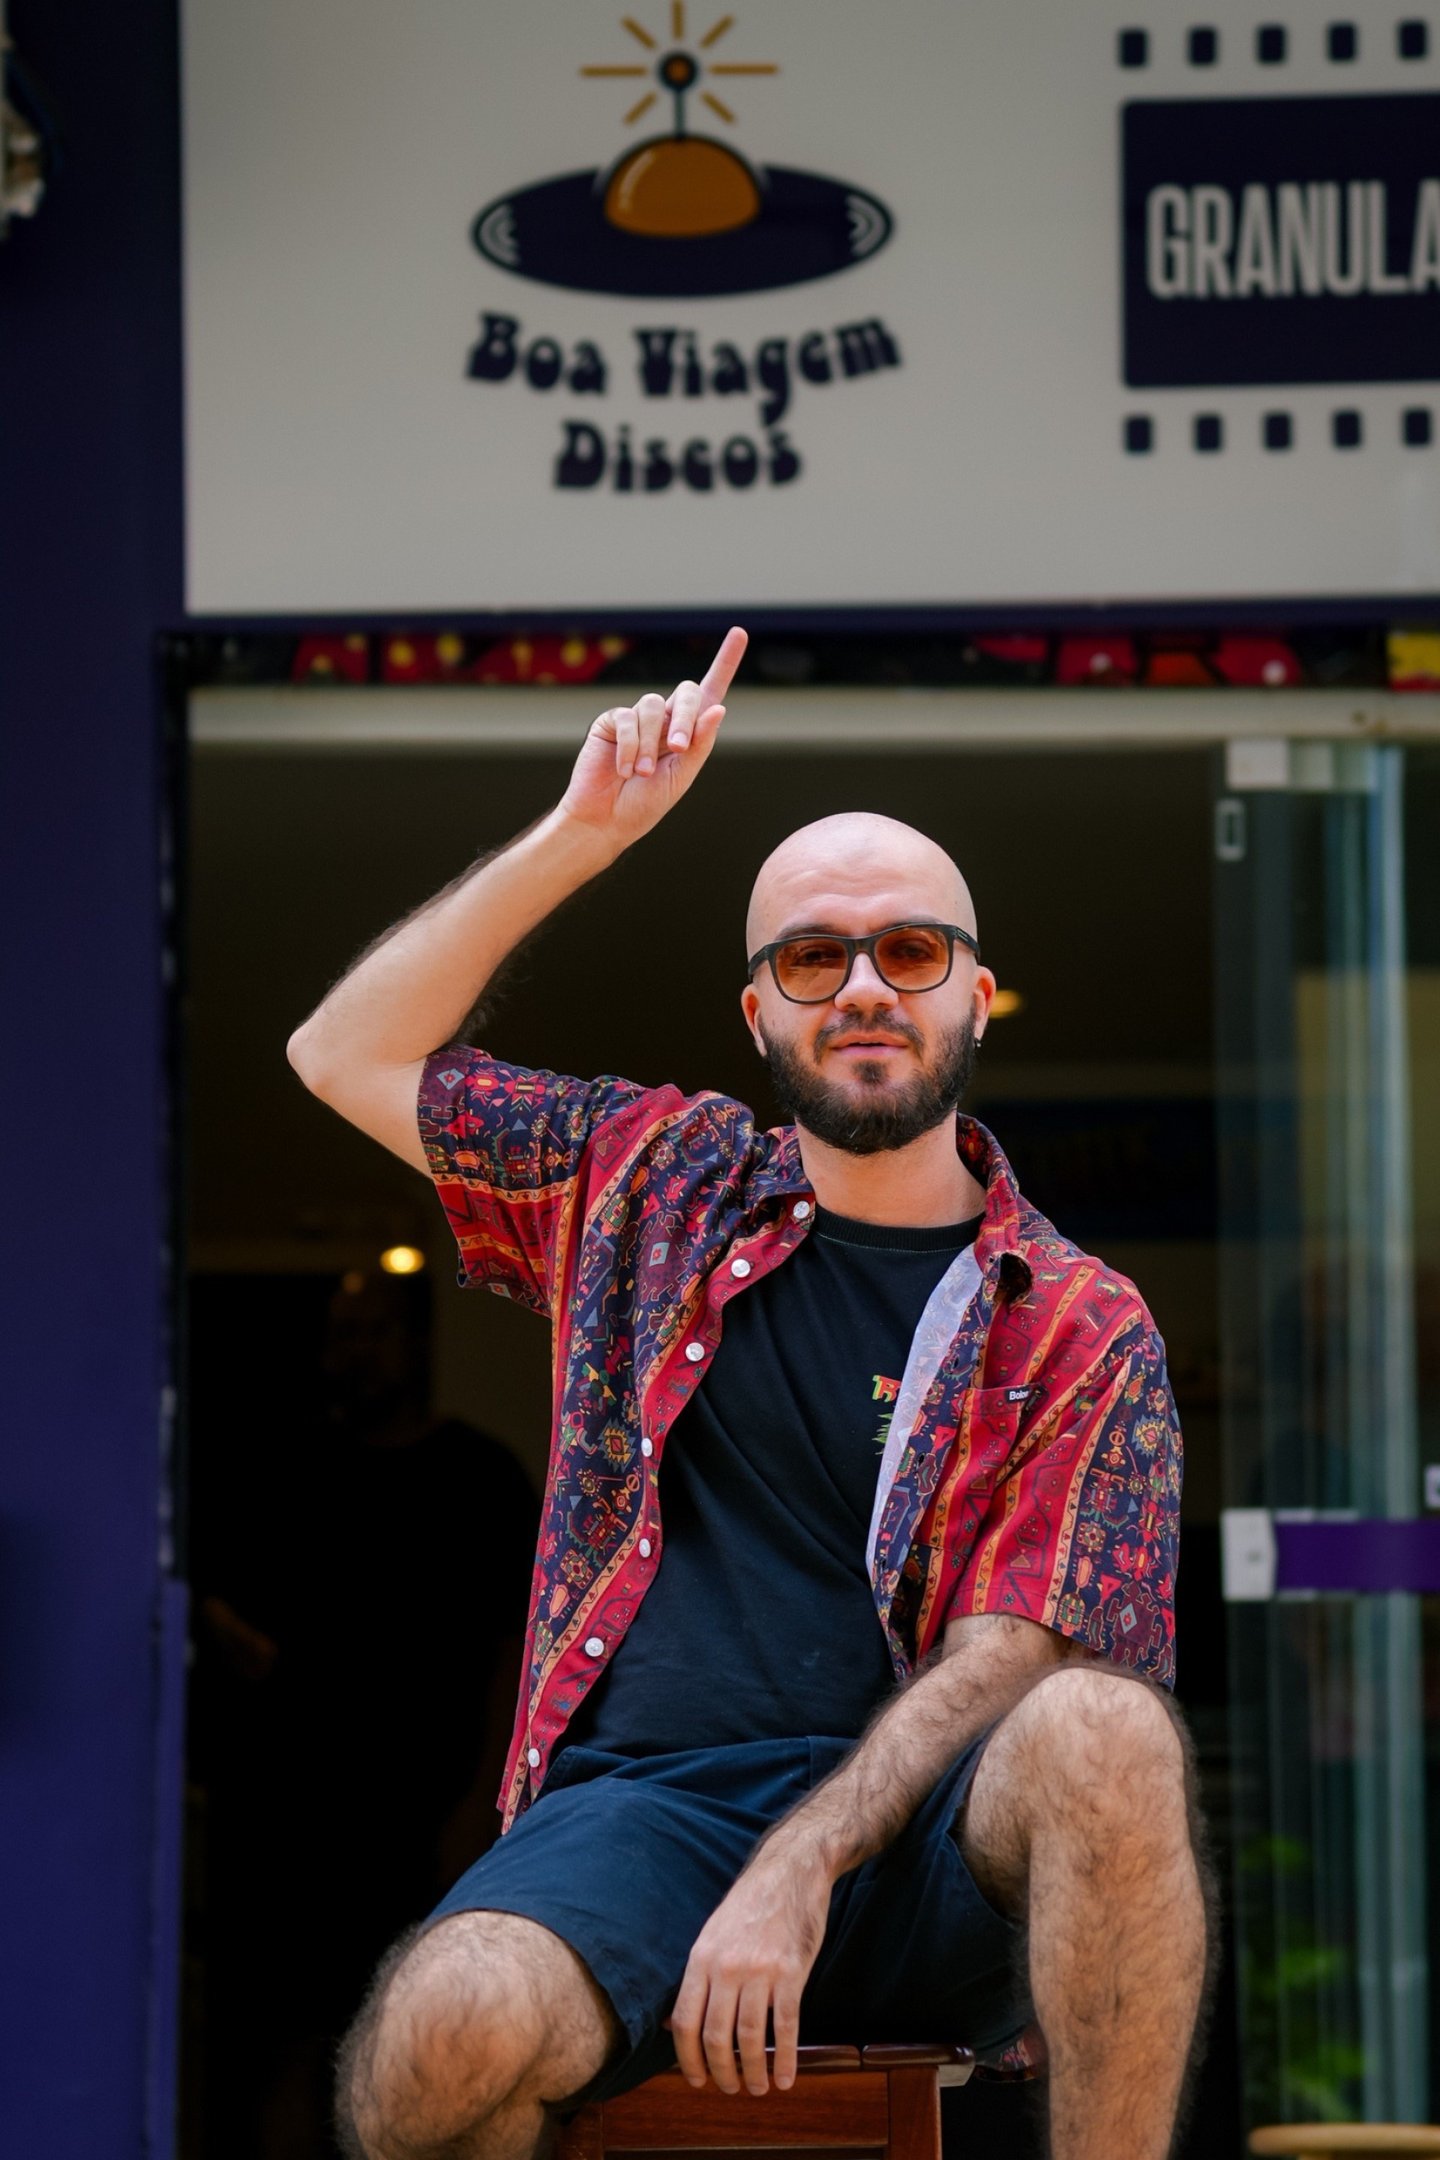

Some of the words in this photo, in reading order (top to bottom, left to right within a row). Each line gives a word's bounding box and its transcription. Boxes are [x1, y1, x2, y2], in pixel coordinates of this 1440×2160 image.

[465, 311, 607, 396] Boa
[634, 316, 901, 427] Viagem
[553, 418, 802, 493] Discos
